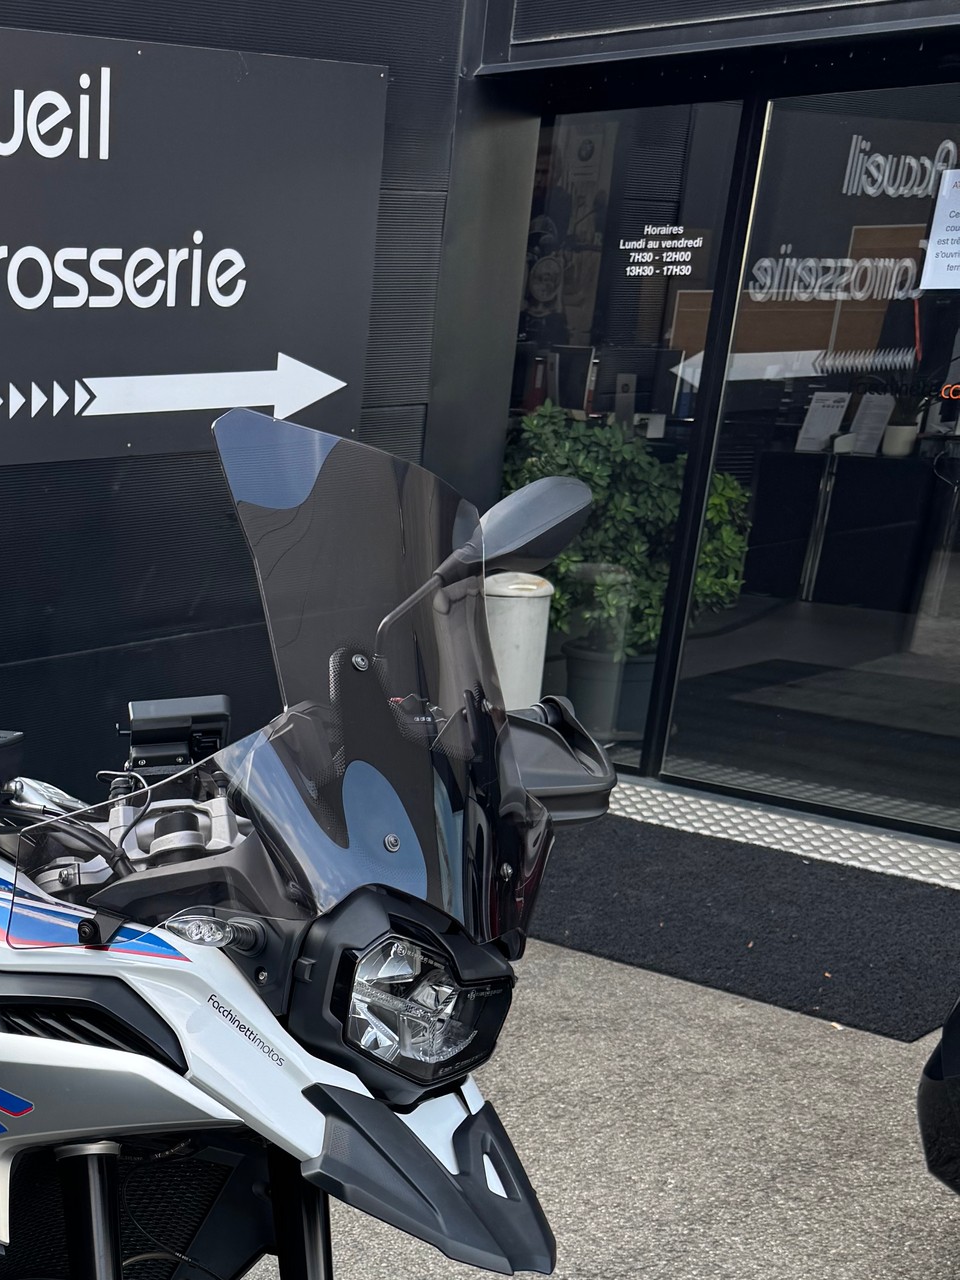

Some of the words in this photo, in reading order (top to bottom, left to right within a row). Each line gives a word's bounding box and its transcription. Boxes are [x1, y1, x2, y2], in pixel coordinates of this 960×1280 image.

[643, 224, 684, 235] Horaires
[619, 239, 646, 250] Lundi
[647, 240, 659, 249] au
[661, 237, 703, 249] vendredi
[629, 252, 653, 263] 7H30
[662, 251, 692, 262] 12H00
[625, 266, 654, 276] 13H30
[662, 265, 692, 276] 17H30
